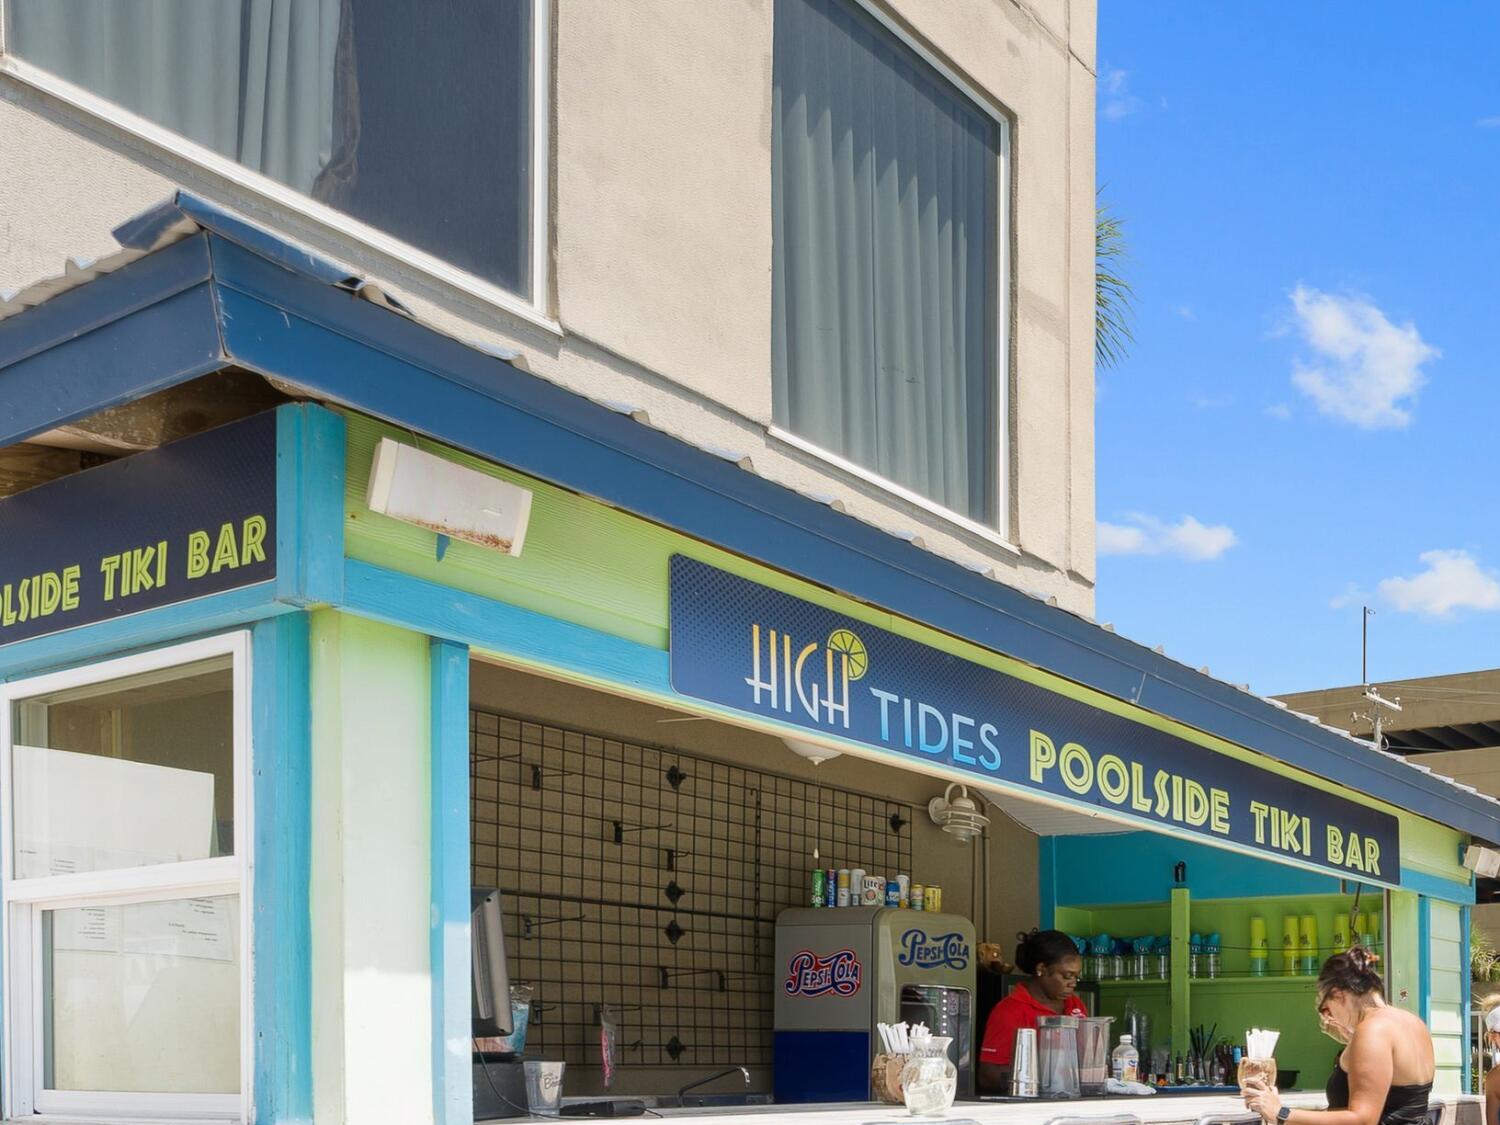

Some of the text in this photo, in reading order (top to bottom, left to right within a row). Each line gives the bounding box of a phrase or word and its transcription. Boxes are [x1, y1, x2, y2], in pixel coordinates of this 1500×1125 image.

[0, 515, 268, 628] LSIDE TIKI BAR
[744, 624, 1381, 877] HIGH TIDES POOLSIDE TIKI BAR
[863, 879, 879, 889] Lite
